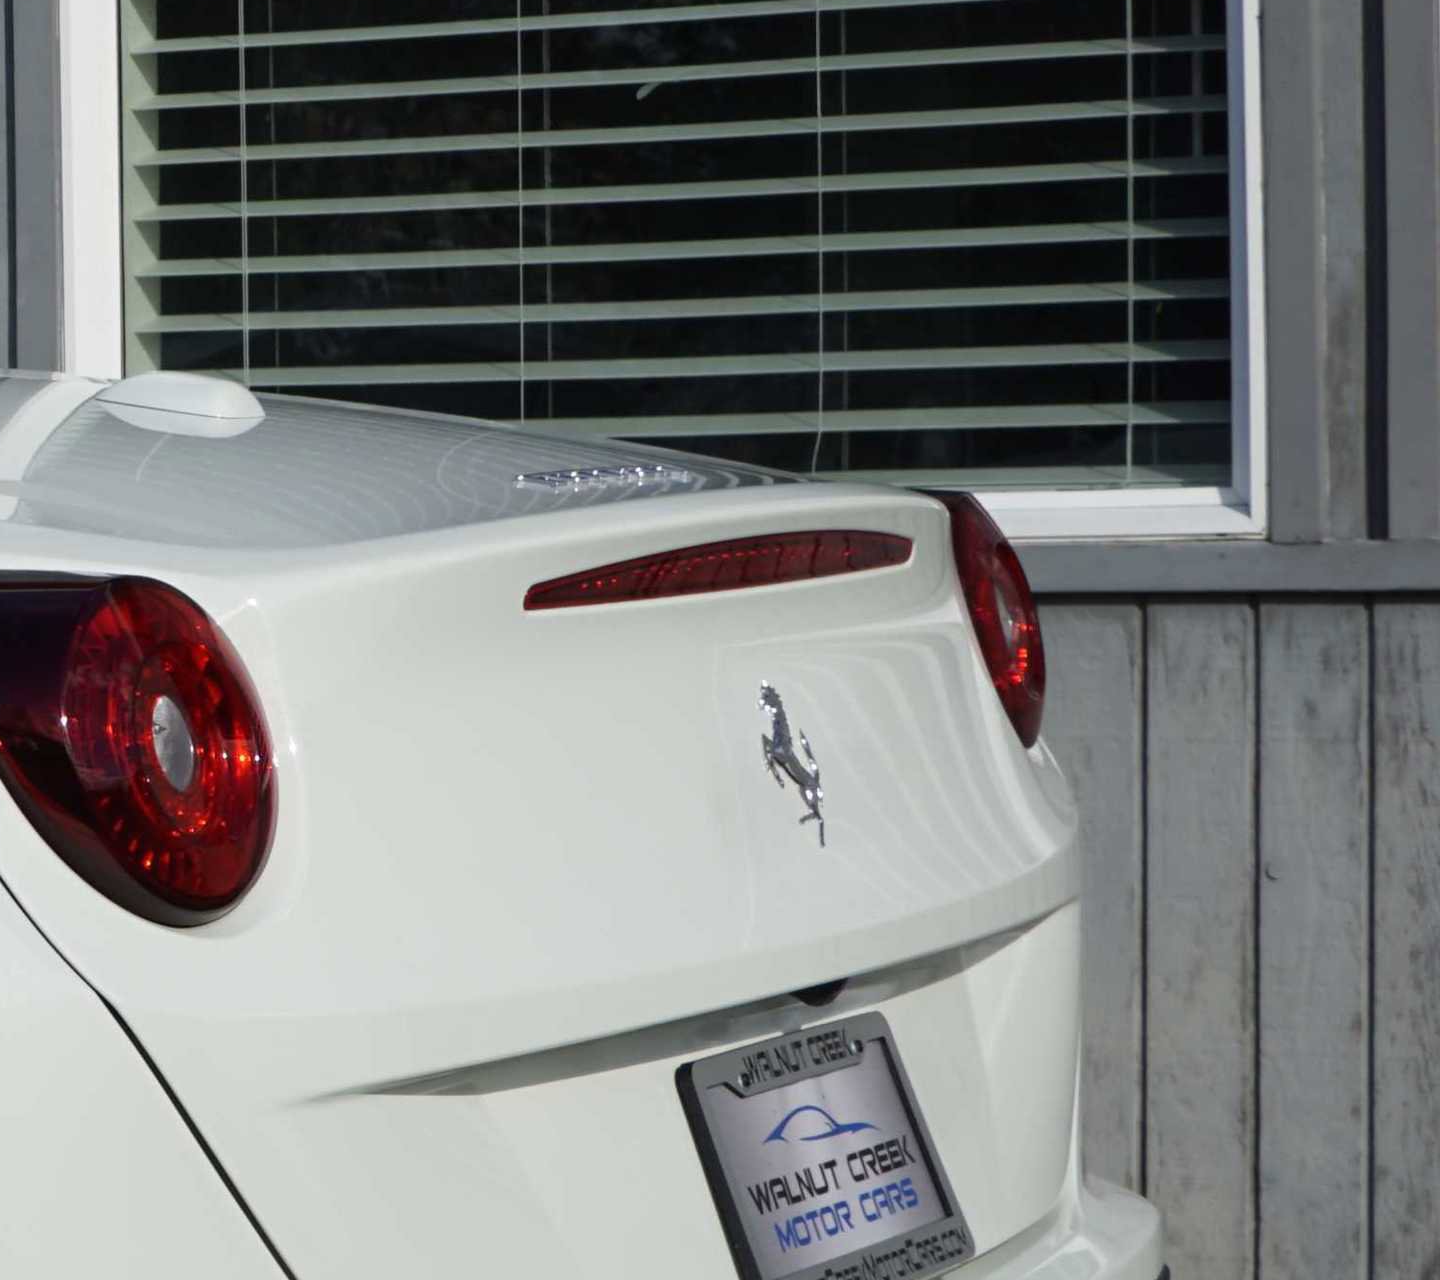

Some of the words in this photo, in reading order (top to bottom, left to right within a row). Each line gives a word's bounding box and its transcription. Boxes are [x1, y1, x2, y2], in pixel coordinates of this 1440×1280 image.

[743, 1041, 806, 1083] WALNUT
[806, 1025, 852, 1065] CREEK
[747, 1159, 840, 1216] WALNUT
[846, 1135, 916, 1183] CREEK
[773, 1200, 854, 1253] MOTOR
[858, 1177, 918, 1222] CARS
